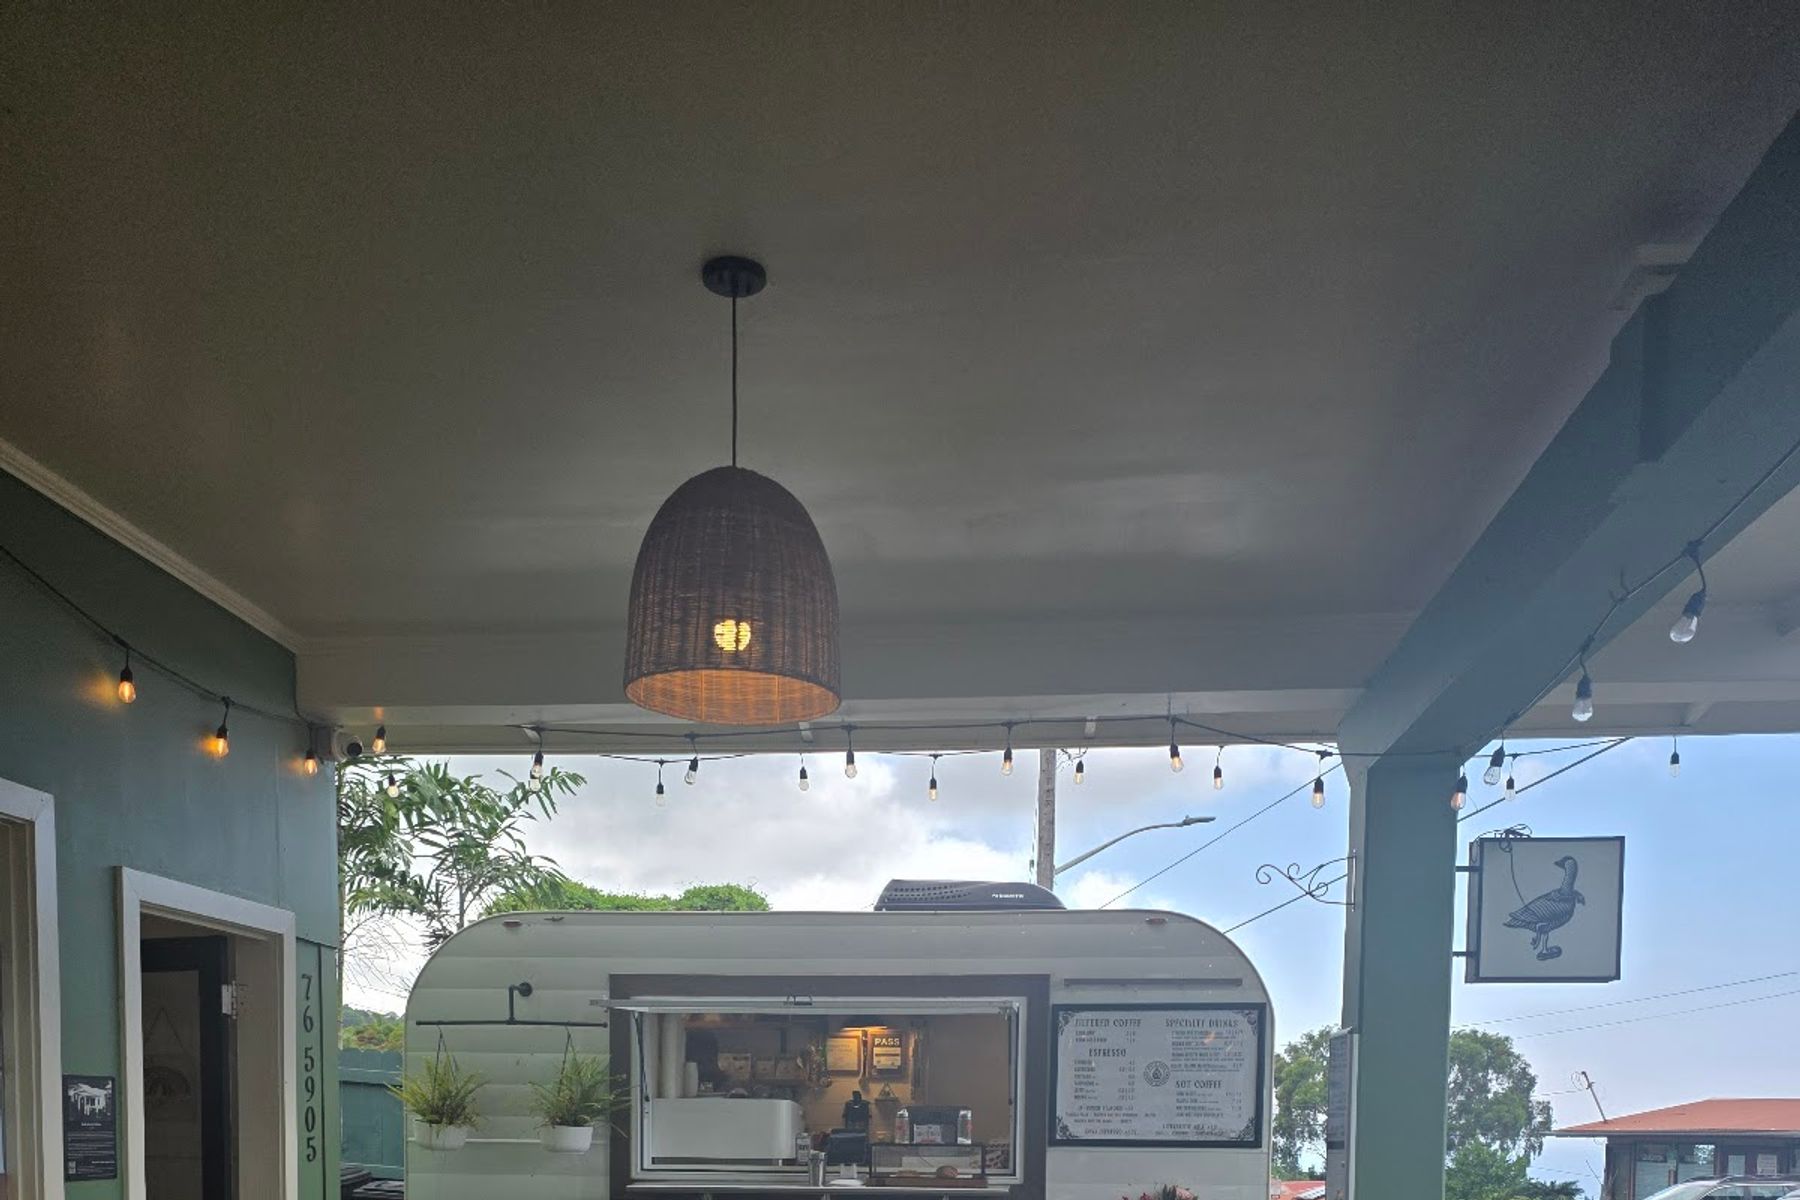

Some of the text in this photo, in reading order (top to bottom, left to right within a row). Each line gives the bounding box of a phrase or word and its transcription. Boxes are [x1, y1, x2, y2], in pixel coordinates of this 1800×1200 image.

[301, 973, 317, 1162] 76 5905
[874, 1037, 900, 1046] PASS
